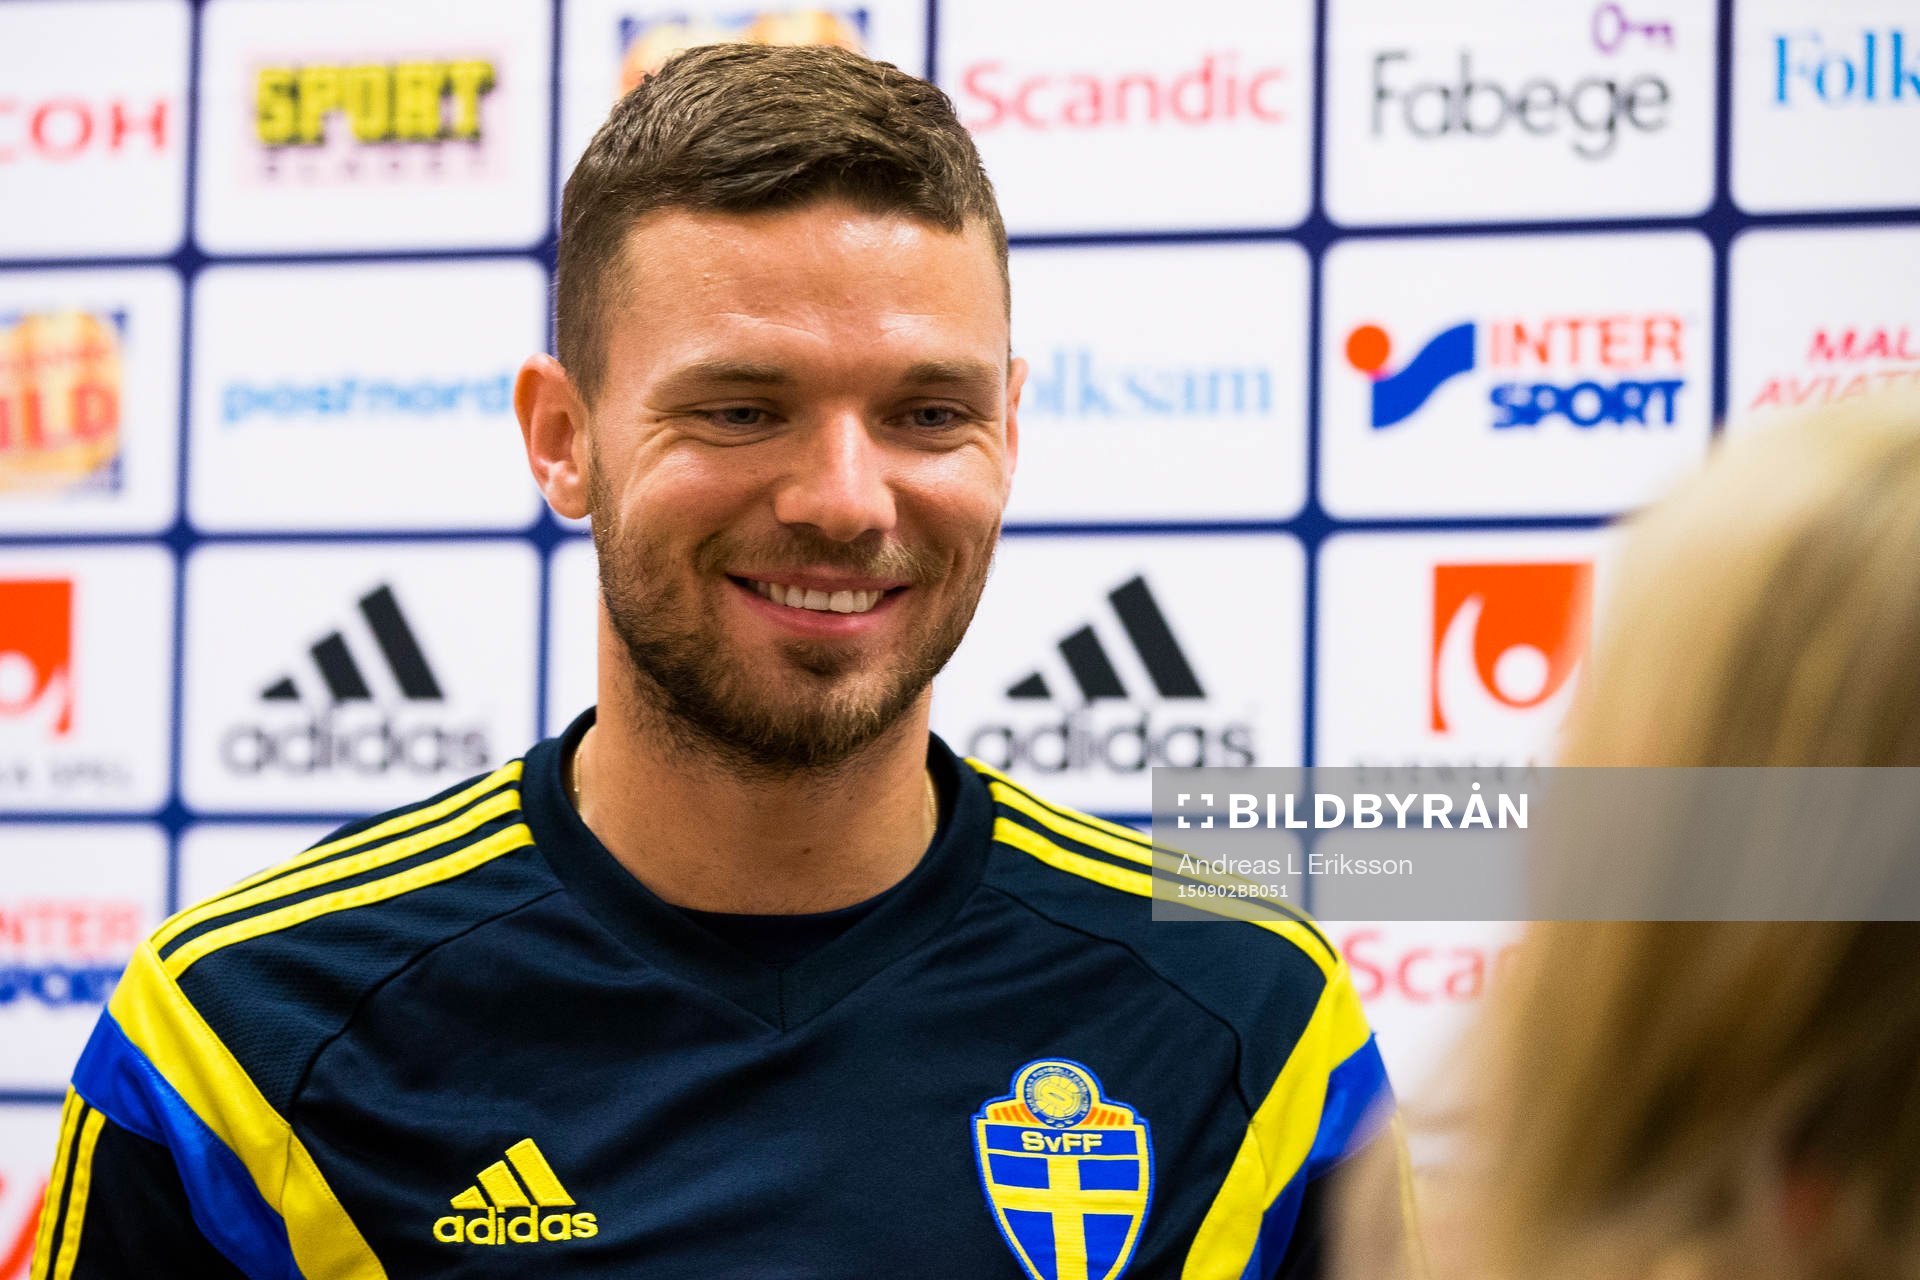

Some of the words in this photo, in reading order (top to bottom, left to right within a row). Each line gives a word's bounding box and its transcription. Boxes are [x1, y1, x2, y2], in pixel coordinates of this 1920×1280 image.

[255, 60, 497, 148] SPORT
[960, 51, 1287, 134] Scandic
[1370, 48, 1671, 160] Fabege
[0, 97, 170, 163] OH
[1488, 313, 1685, 370] INTER
[220, 370, 513, 424] postnord
[1488, 378, 1686, 430] SPORT
[218, 704, 490, 776] adidas
[968, 704, 1256, 775] adidas
[1020, 1131, 1103, 1153] SvFF
[432, 1204, 599, 1246] adidas
